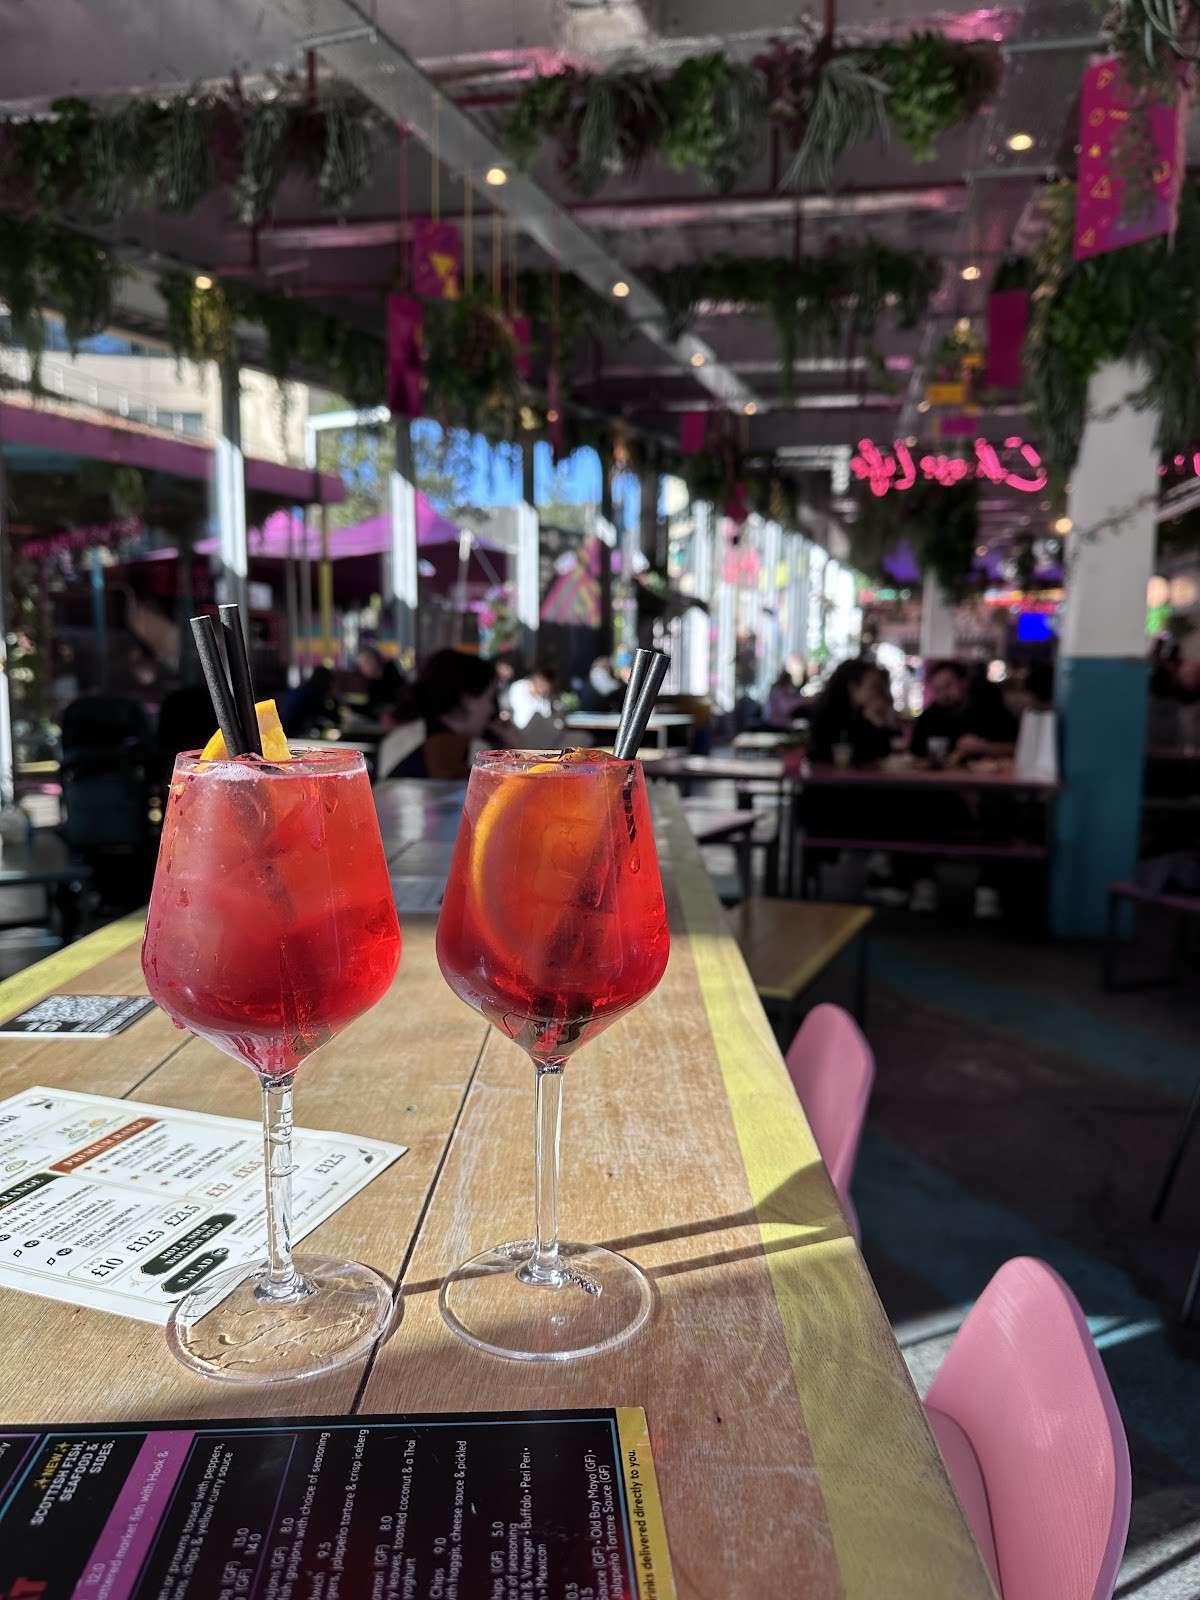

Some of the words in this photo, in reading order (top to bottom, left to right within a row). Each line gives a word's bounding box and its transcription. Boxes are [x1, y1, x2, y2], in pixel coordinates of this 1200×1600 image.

[60, 1138, 117, 1165] PREMIUM
[314, 1153, 346, 1173] £12.5
[206, 1182, 233, 1197] £12
[91, 1258, 124, 1277] £10
[126, 1229, 165, 1252] £12.5
[164, 1204, 200, 1227] £23.5
[160, 1246, 181, 1259] HOT
[187, 1223, 210, 1240] SOUR
[166, 1239, 203, 1264] WONTON
[201, 1221, 224, 1239] SOUP
[178, 1258, 214, 1284] SALAD
[90, 1440, 116, 1474] SIDES.
[157, 1449, 170, 1459] &
[312, 1431, 332, 1473] seasoning
[352, 1428, 370, 1460] iceberg
[403, 1439, 417, 1458] Thai
[454, 1440, 468, 1470] pickled
[42, 1453, 63, 1477] NEW
[147, 1458, 166, 1482] Hook
[204, 1443, 225, 1480] peppers,
[218, 1452, 233, 1478] sauce
[349, 1459, 364, 1482] crisp
[401, 1466, 413, 1475] &
[519, 1451, 531, 1468] Peri
[583, 1453, 597, 1472] (GF)
[628, 1449, 641, 1469] you.
[30, 1469, 70, 1525] SCOTTISH
[62, 1440, 88, 1469] FISH,
[60, 1452, 94, 1501] SEAFOOD
[308, 1474, 319, 1484] of
[344, 1482, 357, 1491] &
[453, 1470, 466, 1478] &
[519, 1469, 531, 1488] Peri
[586, 1473, 601, 1499] Mayo
[598, 1465, 611, 1483] (GF)
[630, 1469, 640, 1480] to
[141, 1482, 155, 1503] with
[196, 1480, 210, 1501] with
[209, 1478, 226, 1503] curry
[300, 1485, 317, 1516] choice
[399, 1475, 413, 1511] coconut
[453, 1479, 465, 1506] sauce
[601, 1484, 614, 1514] Sauce
[629, 1481, 645, 1519] directly
[129, 1503, 145, 1522] fish
[182, 1501, 203, 1534] tossed
[196, 1504, 216, 1536] yellow
[340, 1492, 356, 1527] tartare
[519, 1493, 532, 1530] Buffalo
[588, 1499, 603, 1519] Bay
[296, 1516, 309, 1538] with
[378, 1514, 394, 1532] 8.0
[393, 1512, 408, 1550] toasted
[449, 1507, 463, 1542] cheese
[490, 1520, 506, 1538] 5.0
[589, 1519, 602, 1539] Old
[605, 1514, 619, 1551] Tartare
[115, 1521, 139, 1558] market
[190, 1536, 204, 1546] &
[231, 1527, 250, 1549] 13.0
[243, 1532, 263, 1556] 14.0
[269, 1546, 290, 1570] (GF)
[280, 1516, 296, 1534] 8.0
[315, 1541, 333, 1560] 9.5
[330, 1525, 349, 1572] jalapeño
[508, 1522, 521, 1573] seasoning
[633, 1519, 652, 1570] delivered
[168, 1533, 191, 1574] prawns
[181, 1546, 201, 1576] chips
[285, 1538, 304, 1581] goujons
[373, 1543, 391, 1568] (GF)
[447, 1542, 463, 1583] haggis,
[490, 1550, 506, 1574] (GF)
[519, 1536, 536, 1578] Vinegar
[534, 1542, 549, 1588] Mexican
[591, 1546, 608, 1568] (GF)
[96, 1558, 122, 1600] attered
[163, 1573, 176, 1588] or
[221, 1560, 242, 1586] (GF)
[234, 1568, 254, 1593] (GF)
[386, 1551, 404, 1587] leaves,
[401, 1556, 418, 1600] yoghurt
[505, 1574, 519, 1585] of
[608, 1552, 625, 1600] Jalapeño
[429, 1567, 446, 1599] Chips
[519, 1580, 533, 1590] &
